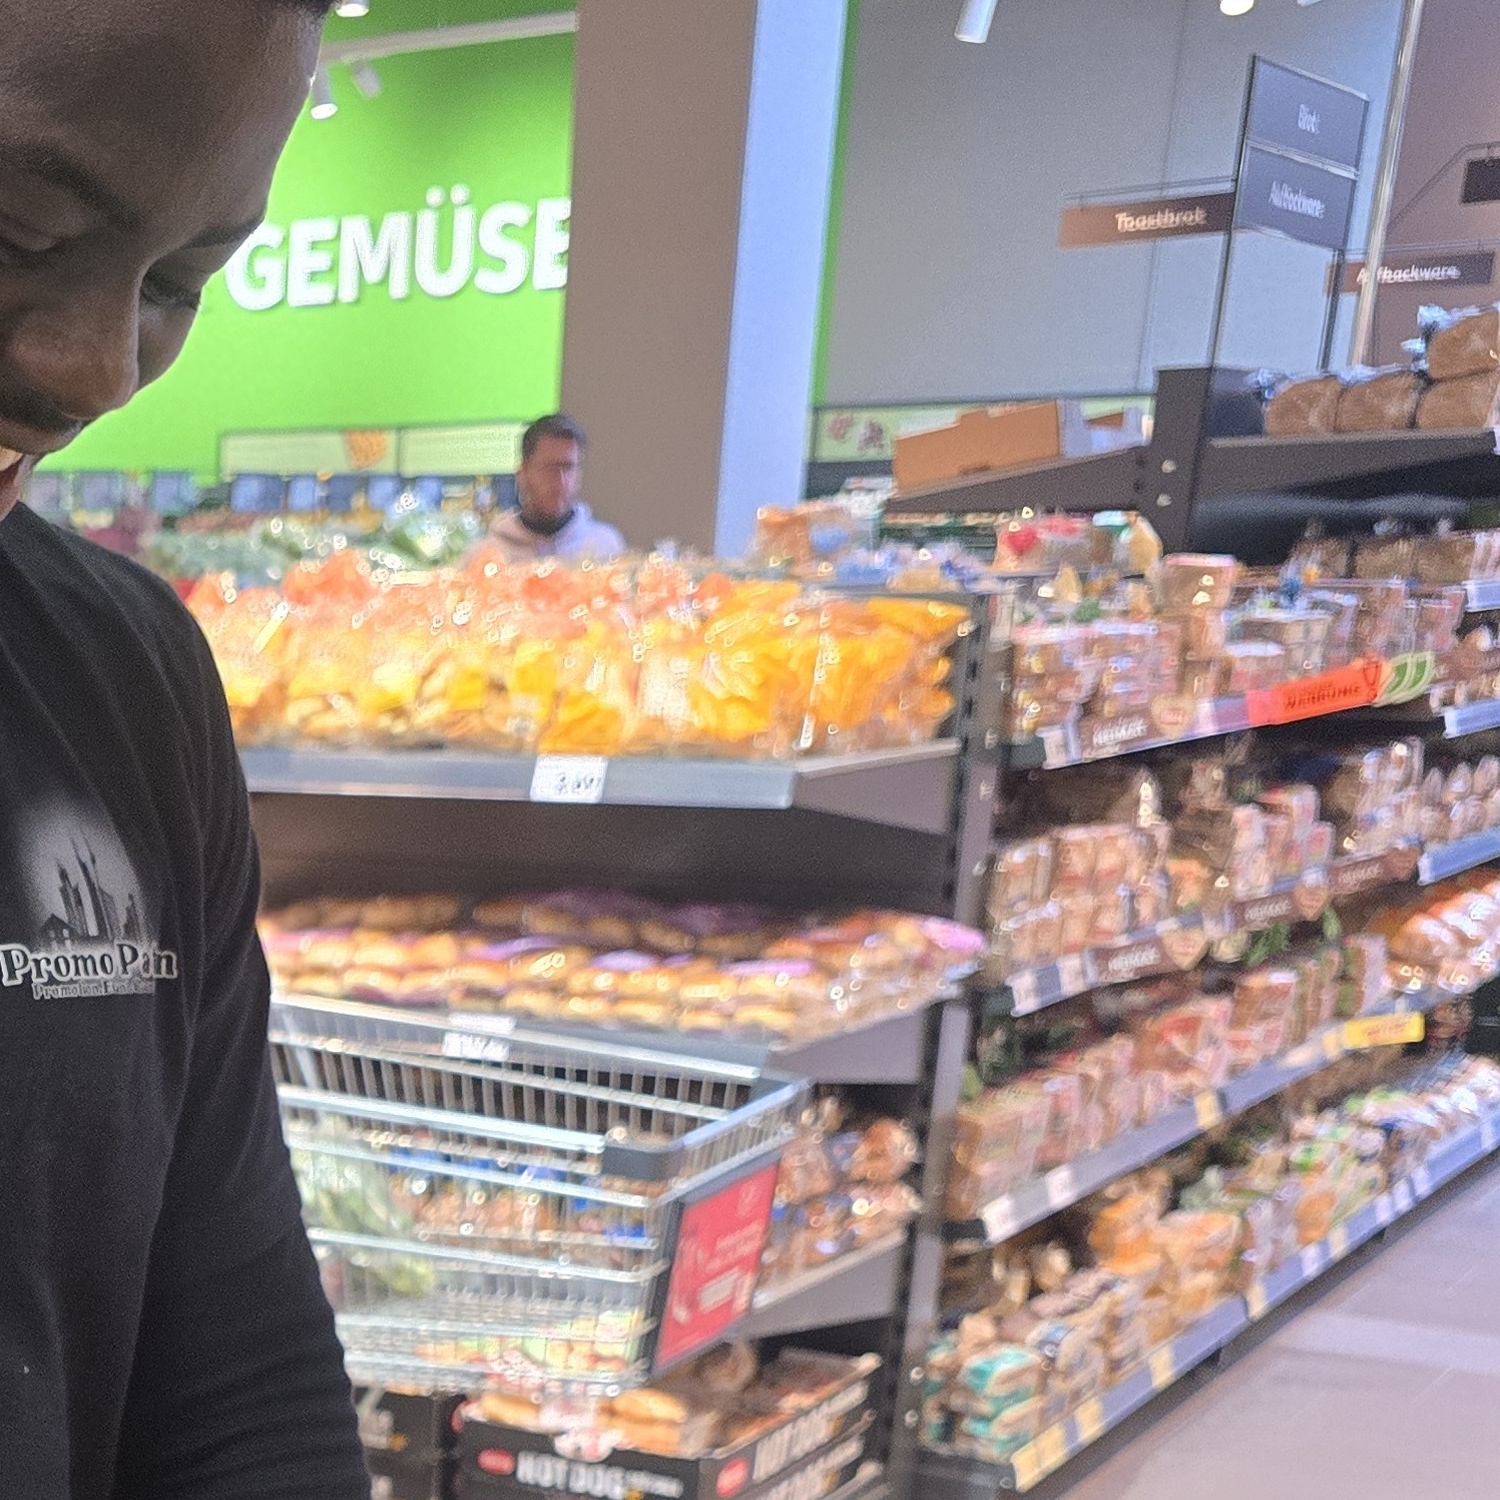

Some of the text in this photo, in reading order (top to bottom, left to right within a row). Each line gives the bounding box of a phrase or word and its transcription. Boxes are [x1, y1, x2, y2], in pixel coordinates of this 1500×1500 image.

[225, 183, 571, 312] GEMÜSE
[1356, 264, 1461, 284] Afbackware
[516, 1450, 568, 1490] HOT
[568, 1462, 626, 1500] DOG
